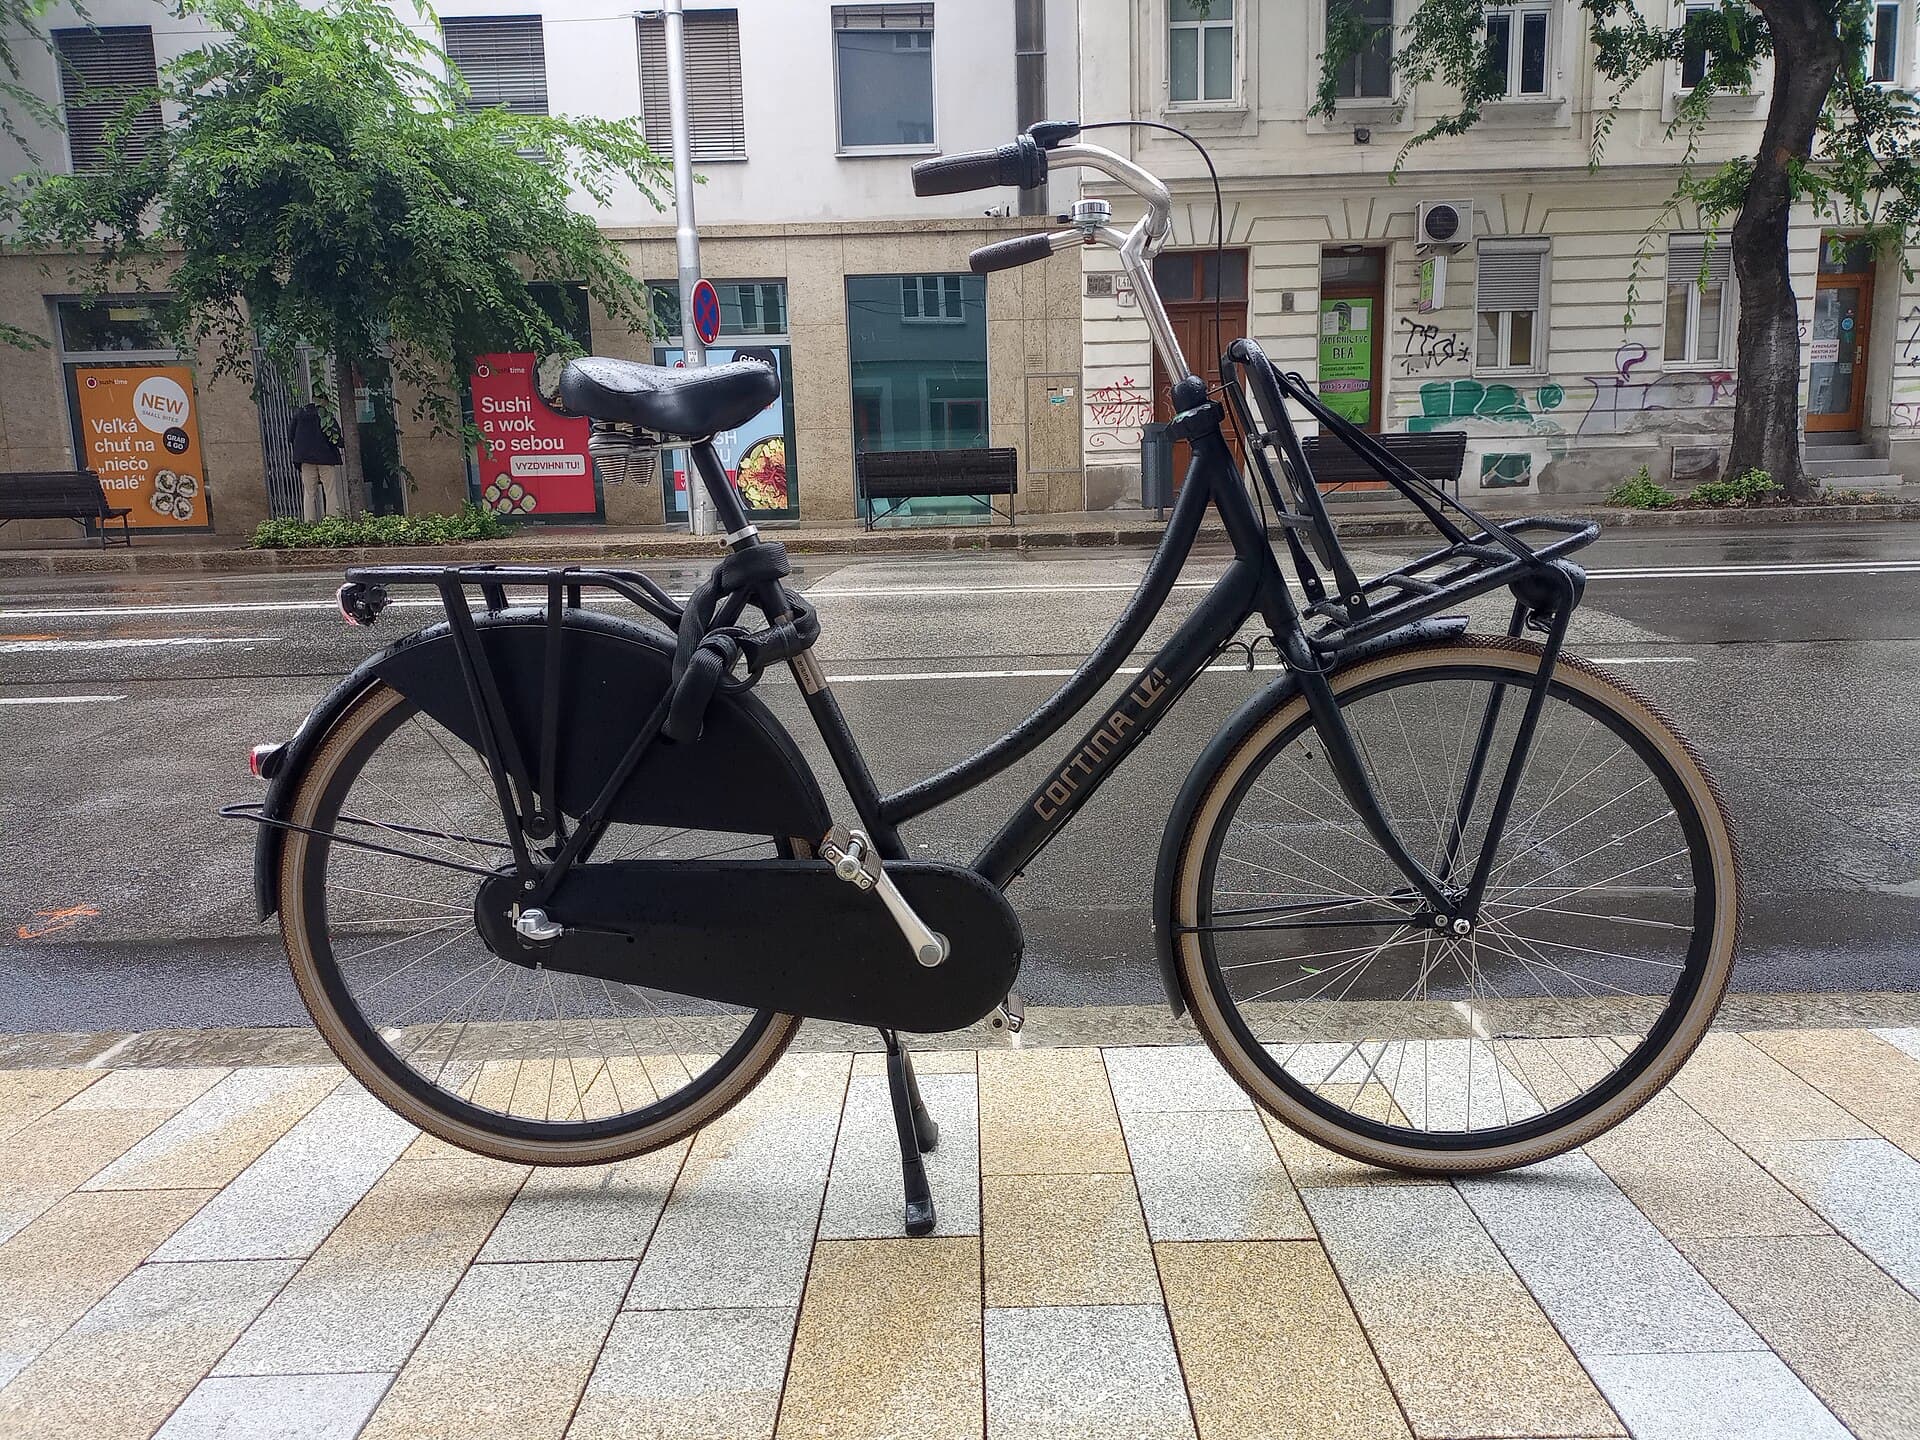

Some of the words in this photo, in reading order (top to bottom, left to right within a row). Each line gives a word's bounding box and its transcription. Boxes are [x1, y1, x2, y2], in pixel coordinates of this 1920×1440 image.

[141, 392, 183, 415] NEW
[482, 396, 531, 413] Sushi
[142, 410, 161, 419] SMALL
[91, 418, 138, 433] Veľká
[483, 420, 494, 432] a
[499, 416, 536, 432] wok
[95, 436, 131, 453] chuť
[135, 440, 155, 452] na
[166, 434, 186, 443] GRAB
[510, 435, 564, 450] sebou
[516, 462, 563, 470] VYZDVIHNI
[566, 461, 580, 470] TU!
[1033, 710, 1136, 822] CORTINA
